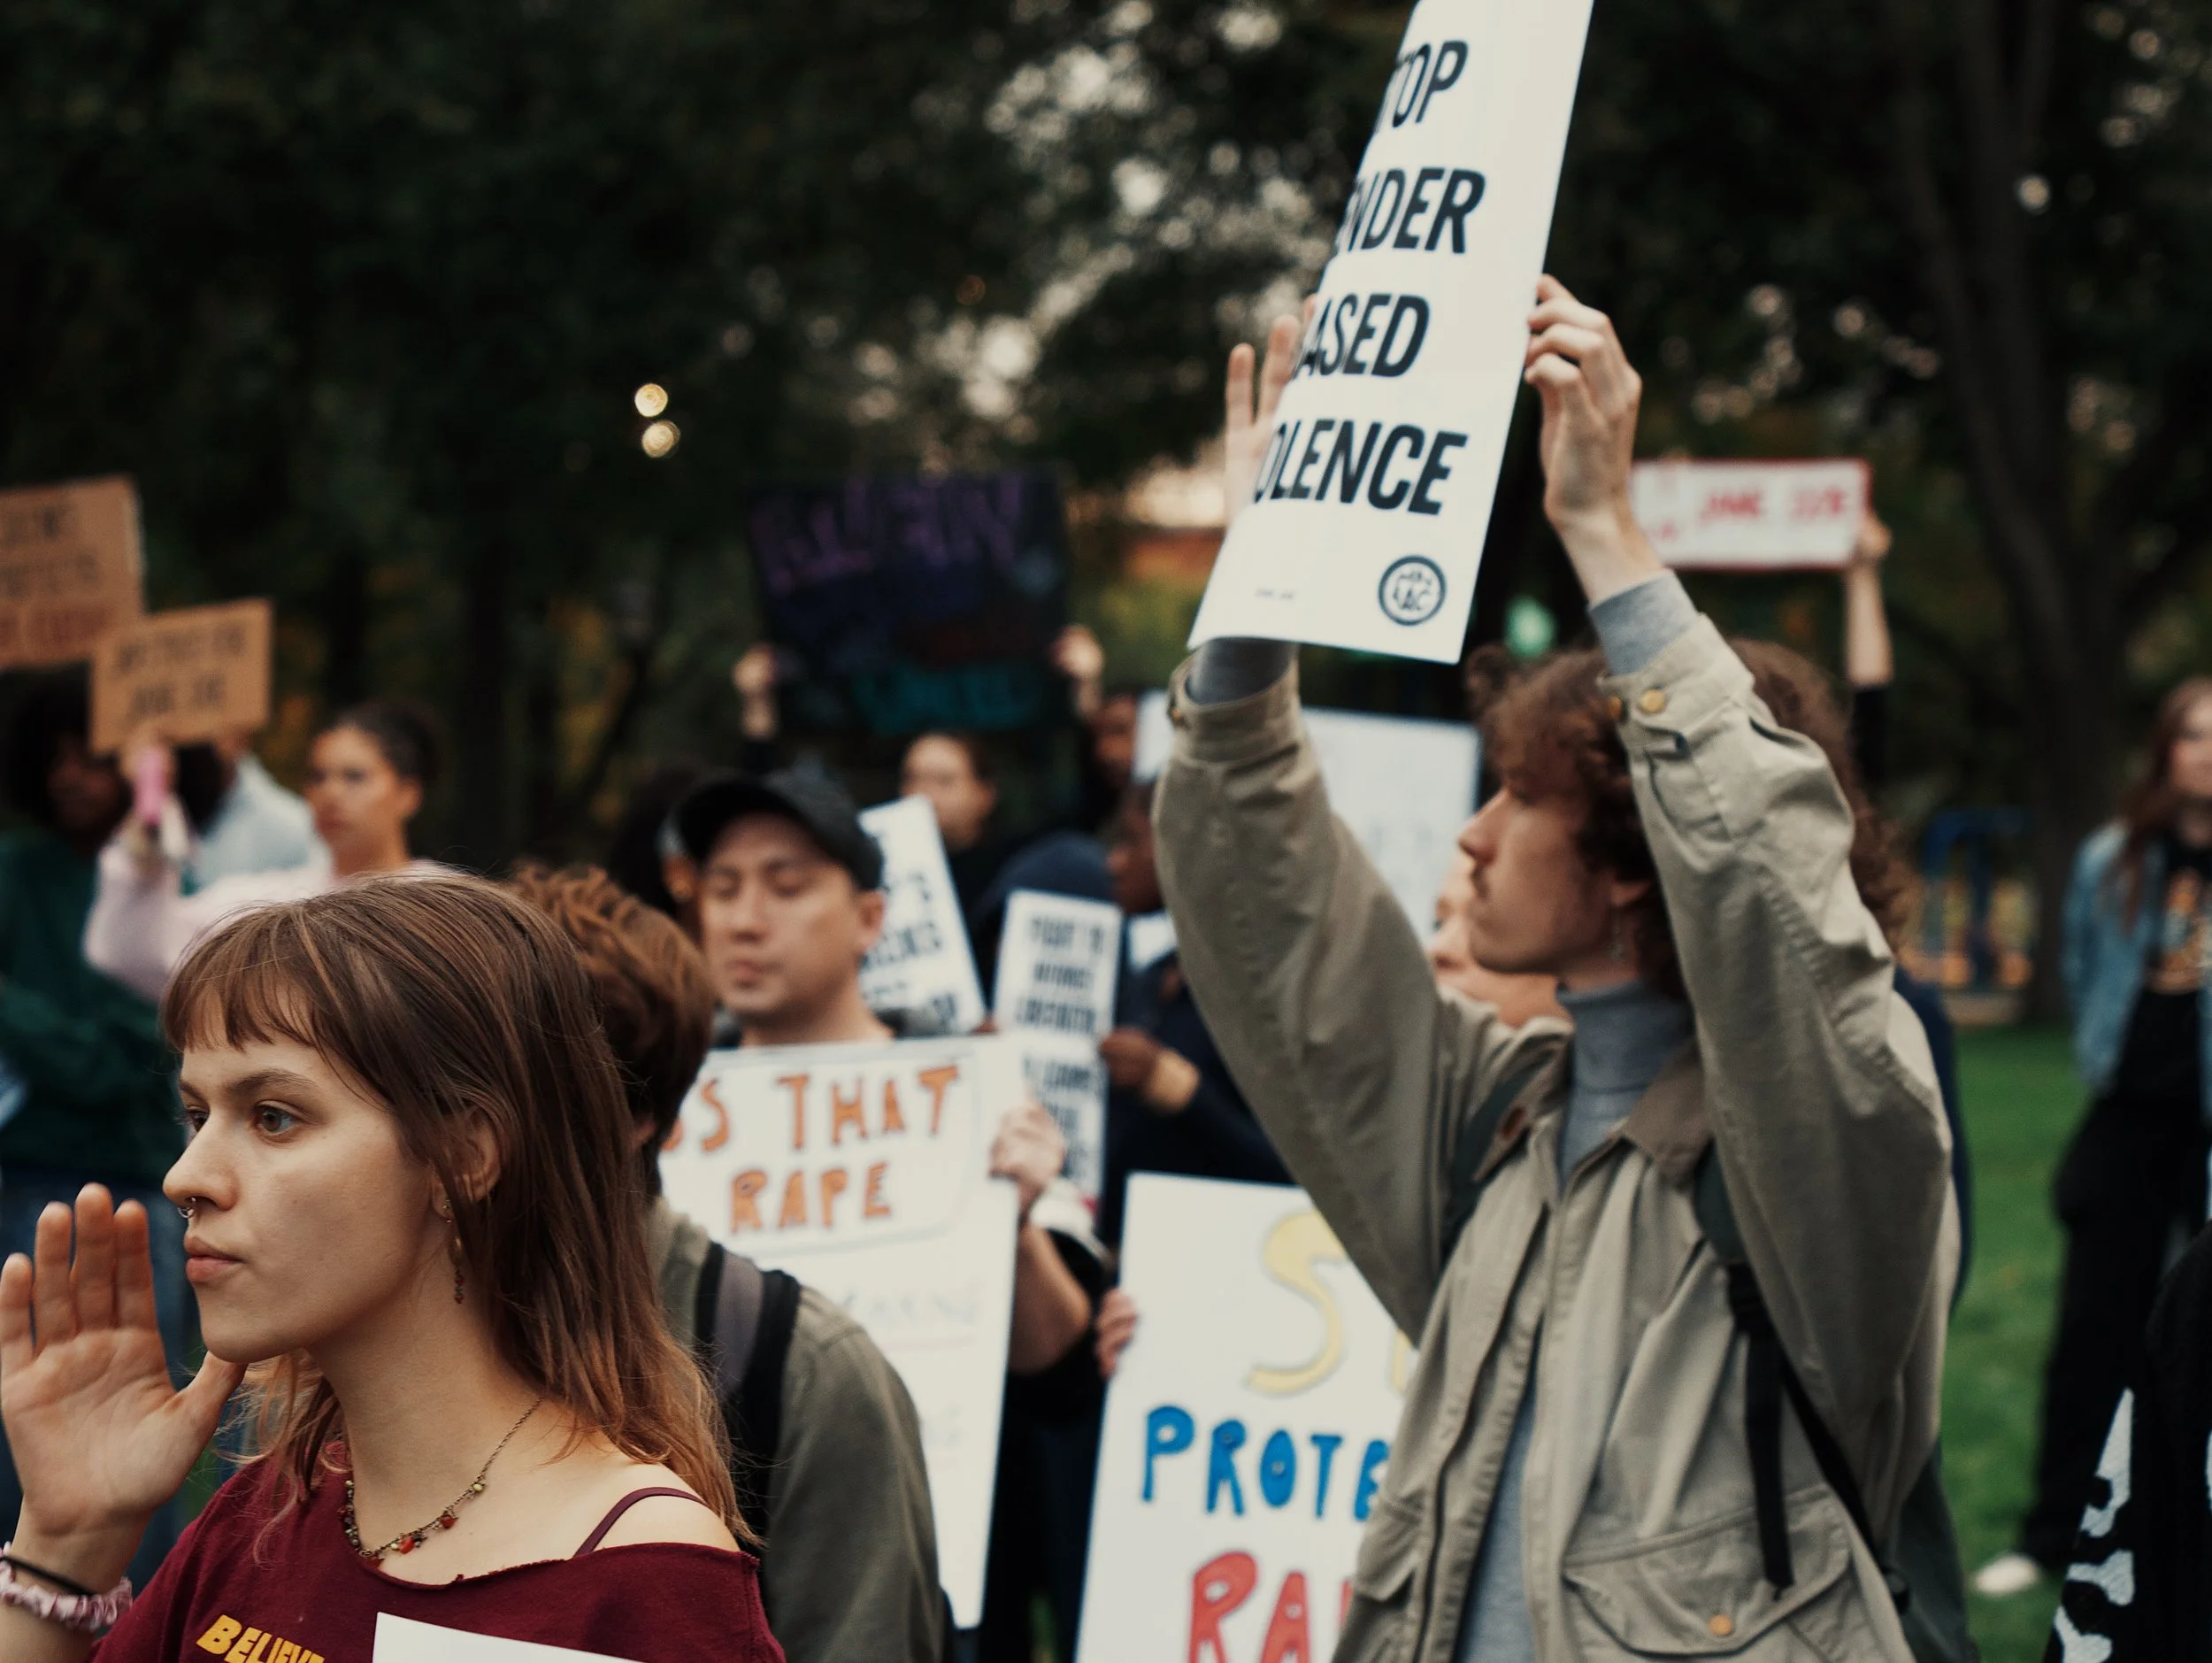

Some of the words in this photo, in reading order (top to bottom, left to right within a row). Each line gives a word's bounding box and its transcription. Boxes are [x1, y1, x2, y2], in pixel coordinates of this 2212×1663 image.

[1338, 166, 1486, 254] NDER
[775, 1065, 958, 1151] THAT
[731, 1160, 892, 1230] RAPE
[196, 1613, 326, 1663] BELIEV
[1187, 1551, 1353, 1663] RA
